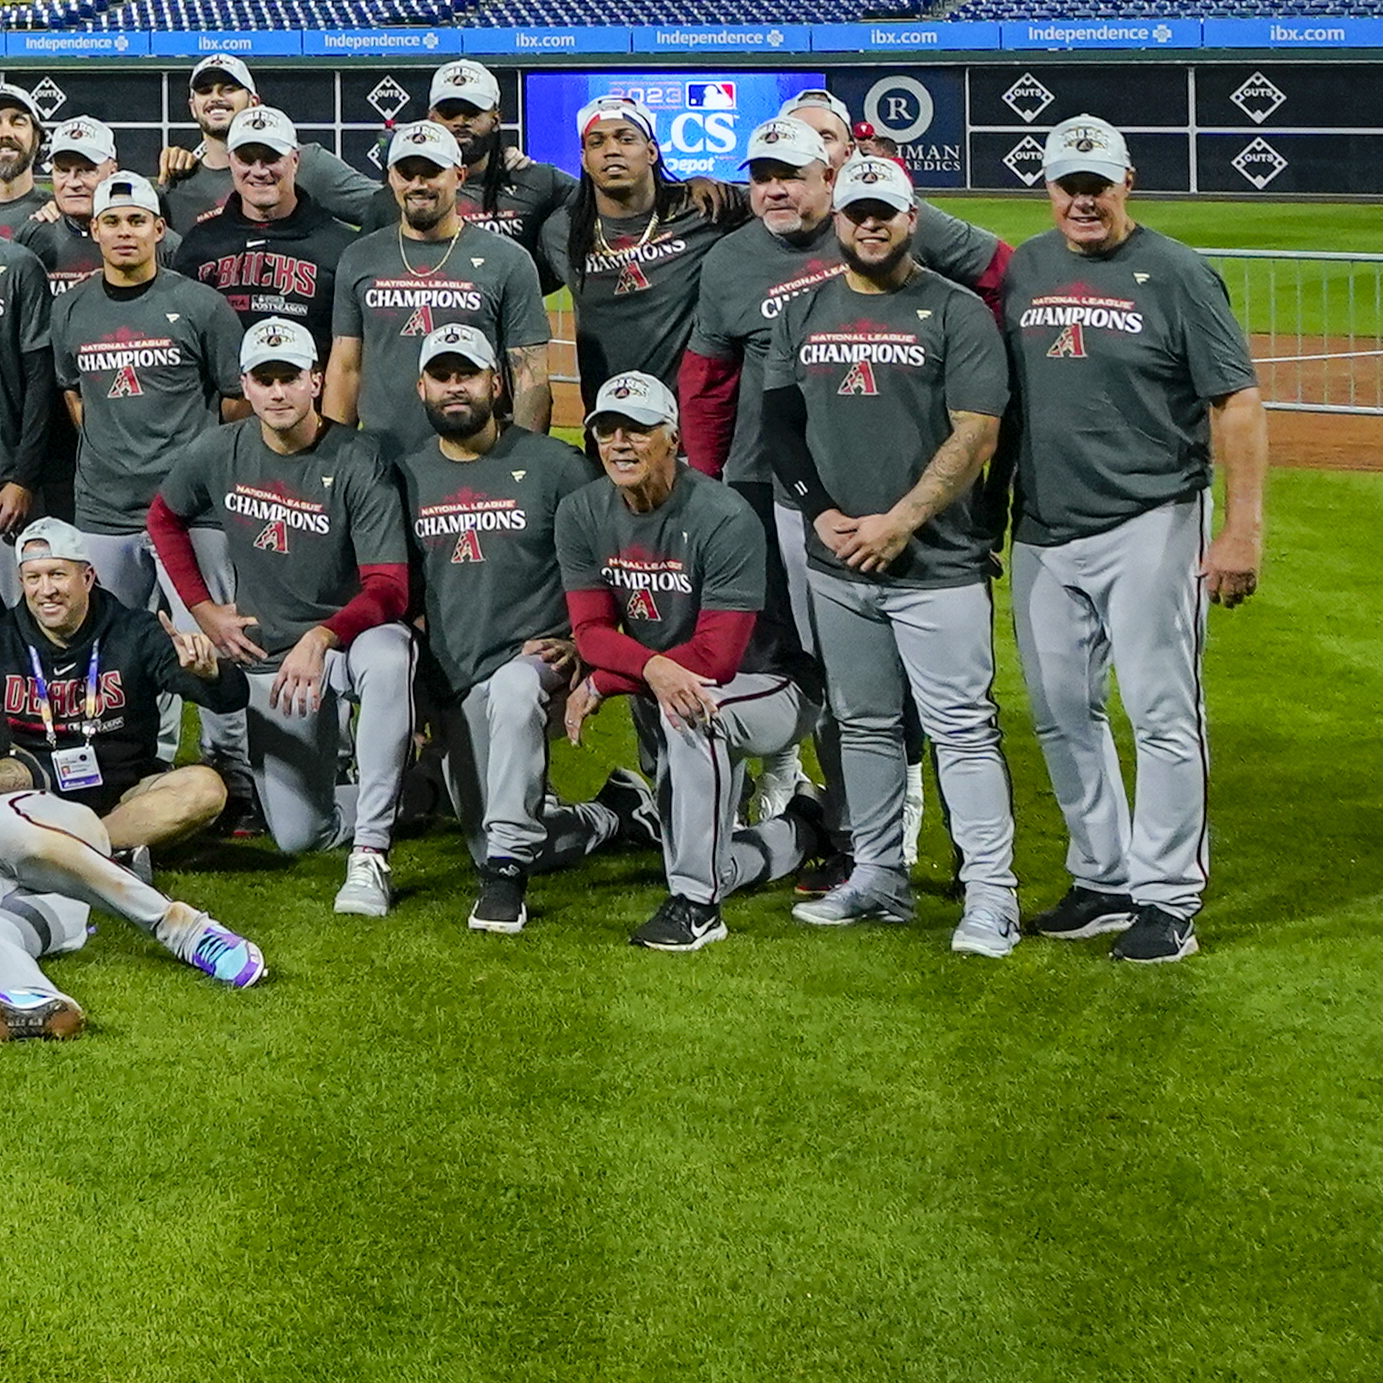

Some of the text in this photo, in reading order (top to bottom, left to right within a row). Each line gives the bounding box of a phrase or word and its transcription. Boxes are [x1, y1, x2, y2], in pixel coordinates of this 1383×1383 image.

[324, 32, 421, 50] Independence
[515, 32, 575, 48] ibx.com
[656, 30, 763, 47] Independence
[870, 28, 938, 45] ibx.com
[1028, 25, 1149, 44] Independence
[1269, 24, 1345, 42] ibx.com
[25, 37, 113, 51] Independence
[198, 35, 252, 50] ibx.com
[376, 88, 401, 98] OUTS
[1014, 87, 1042, 97] OUTS
[1243, 87, 1273, 97] OUTS
[887, 96, 912, 120] R
[653, 113, 737, 154] LCS
[896, 144, 961, 161] HMAN
[1015, 151, 1043, 162] OUTS
[1245, 153, 1273, 163] OUTS
[585, 236, 688, 274] HAMPIONS
[374, 279, 474, 290] NATIONAL LEAGUE
[768, 270, 823, 296] NATIONAL
[250, 300, 308, 316] POSTSEASON
[365, 288, 482, 312] CHAMPIONS
[1031, 295, 1135, 309] NATIONAL LEAGUE
[1020, 307, 1143, 334] CHAMPIONS
[80, 338, 173, 353] NATIONAL LEAGUE
[810, 333, 918, 343] NATIONAL LEAGUE
[77, 347, 182, 372] CHAMPIONS
[800, 342, 925, 367] CHAMPIONS
[235, 484, 324, 512] NATIONAL LEAGUE
[224, 492, 330, 535] CHAMPIONS
[421, 500, 517, 516] NATIONAL LEAGUE
[414, 509, 527, 538] CHAMPIONS
